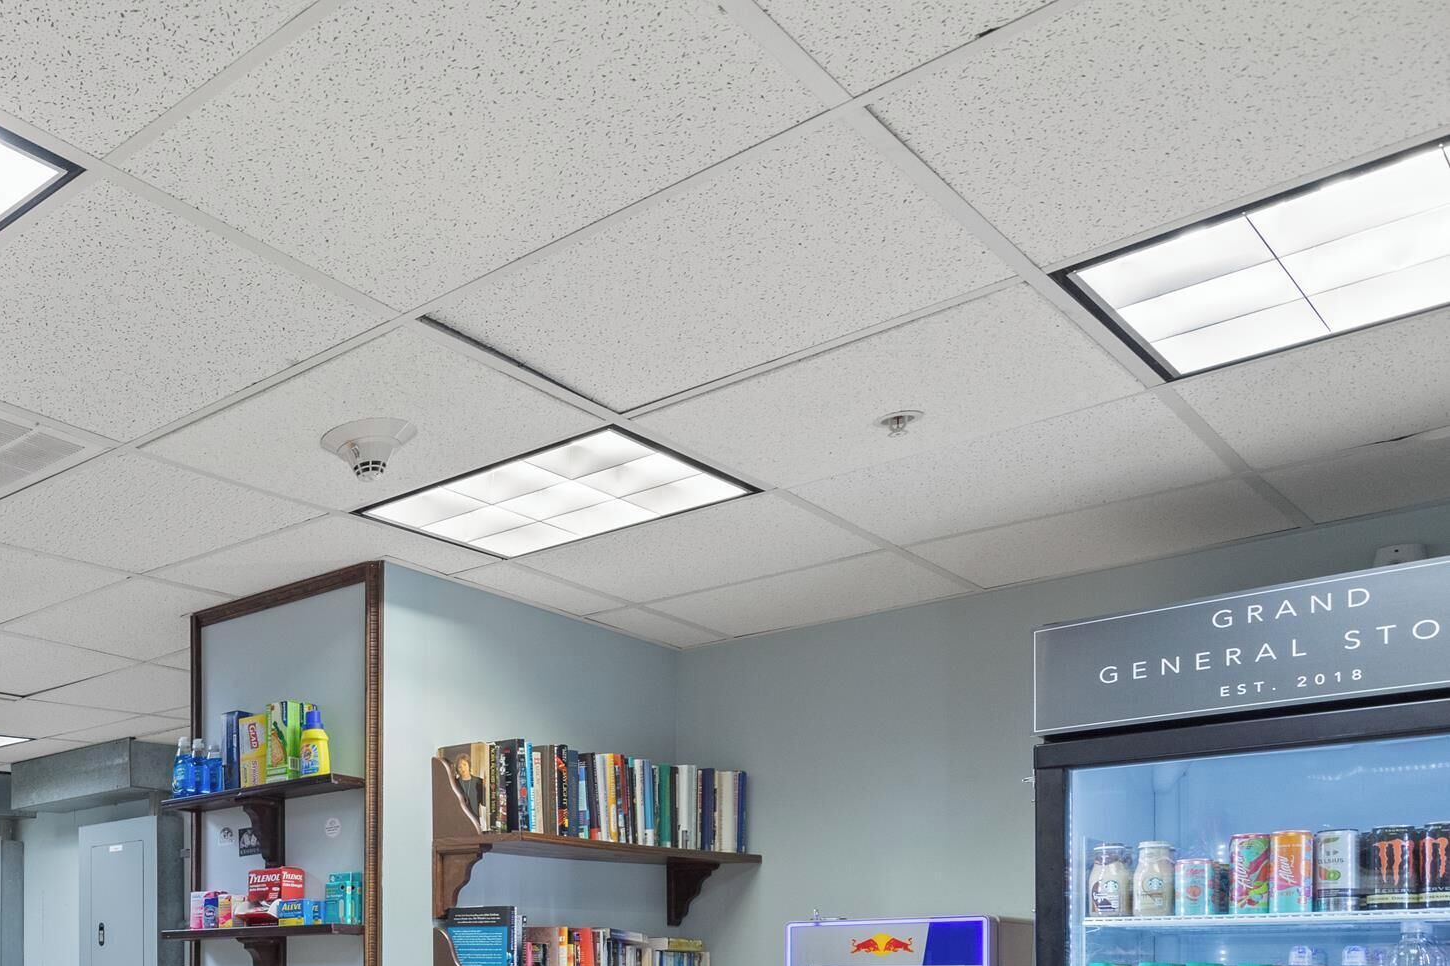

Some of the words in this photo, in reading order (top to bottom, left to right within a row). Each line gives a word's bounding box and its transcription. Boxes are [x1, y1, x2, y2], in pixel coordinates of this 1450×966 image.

[1211, 587, 1372, 629] GRAND
[1098, 638, 1308, 685] GENERAL
[1343, 618, 1441, 651] STO
[1219, 680, 1277, 697] EST.
[1296, 668, 1363, 688] 2018
